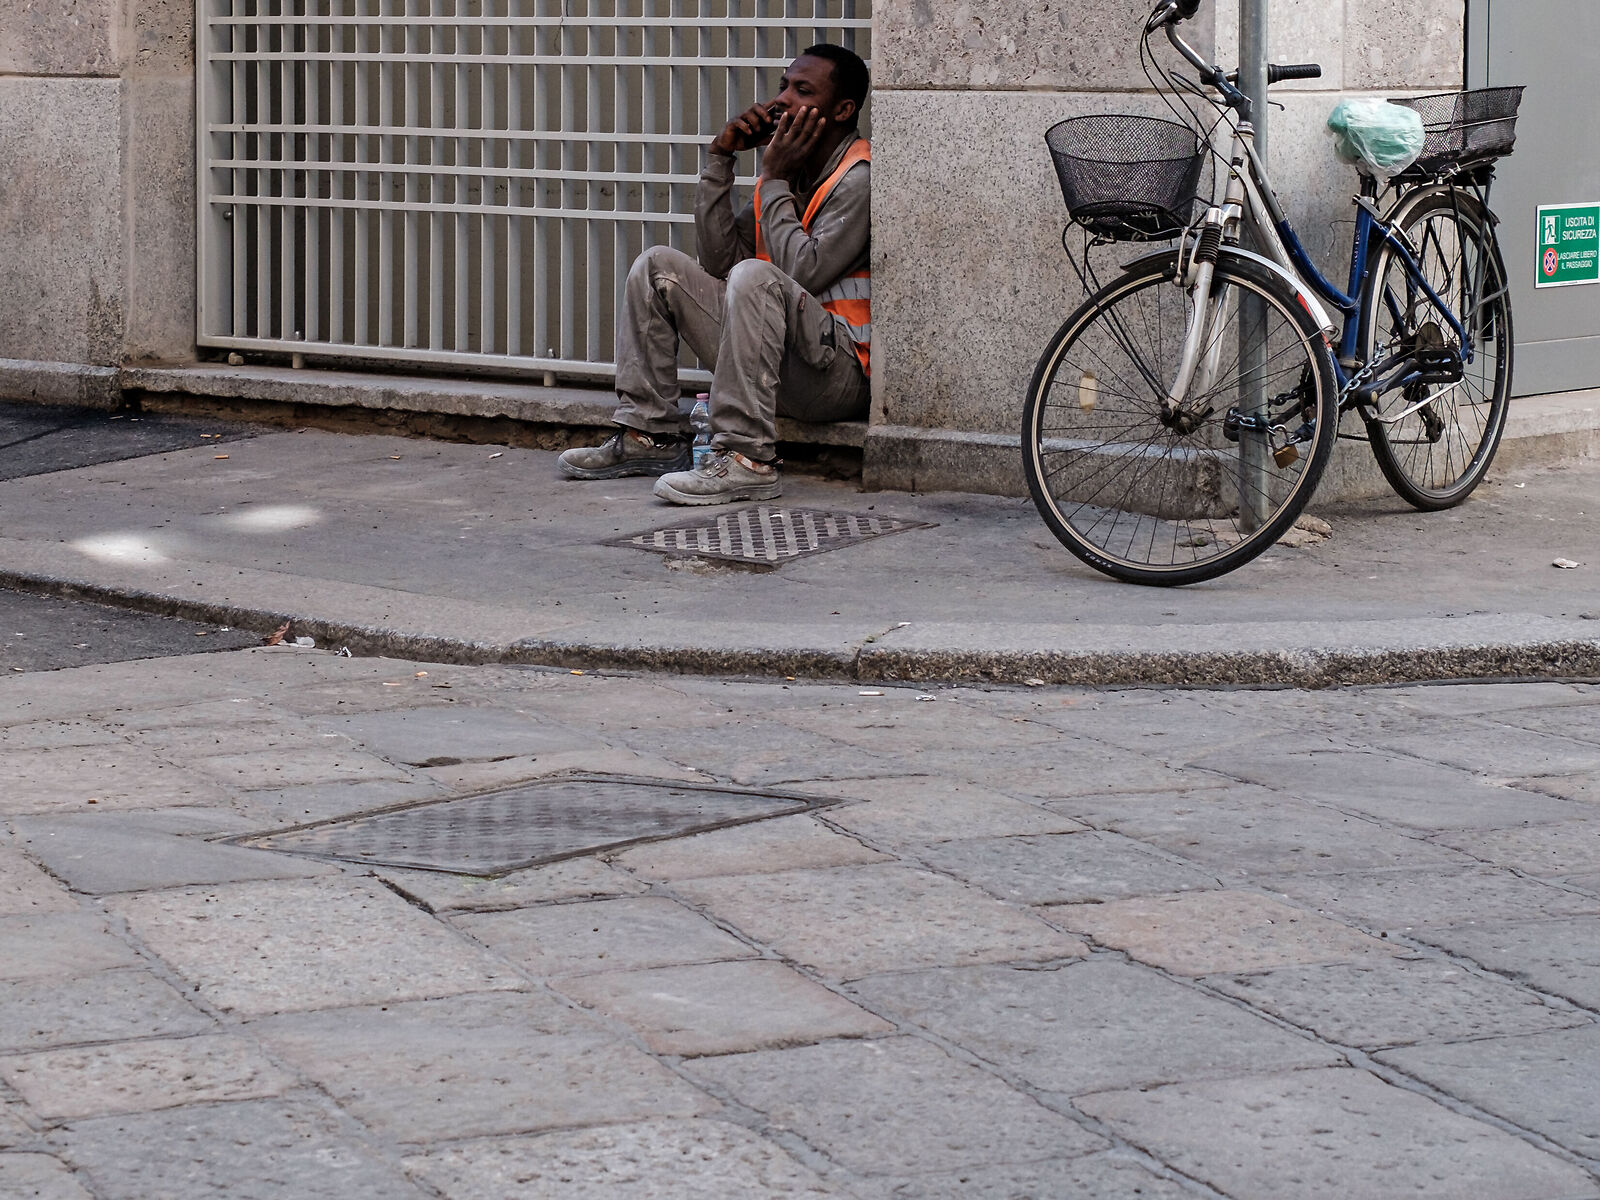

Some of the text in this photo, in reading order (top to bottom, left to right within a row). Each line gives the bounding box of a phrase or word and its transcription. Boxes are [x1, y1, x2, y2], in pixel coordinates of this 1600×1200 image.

[1565, 216, 1594, 227] USCITA DI
[1562, 229, 1596, 240] SICUREZZA
